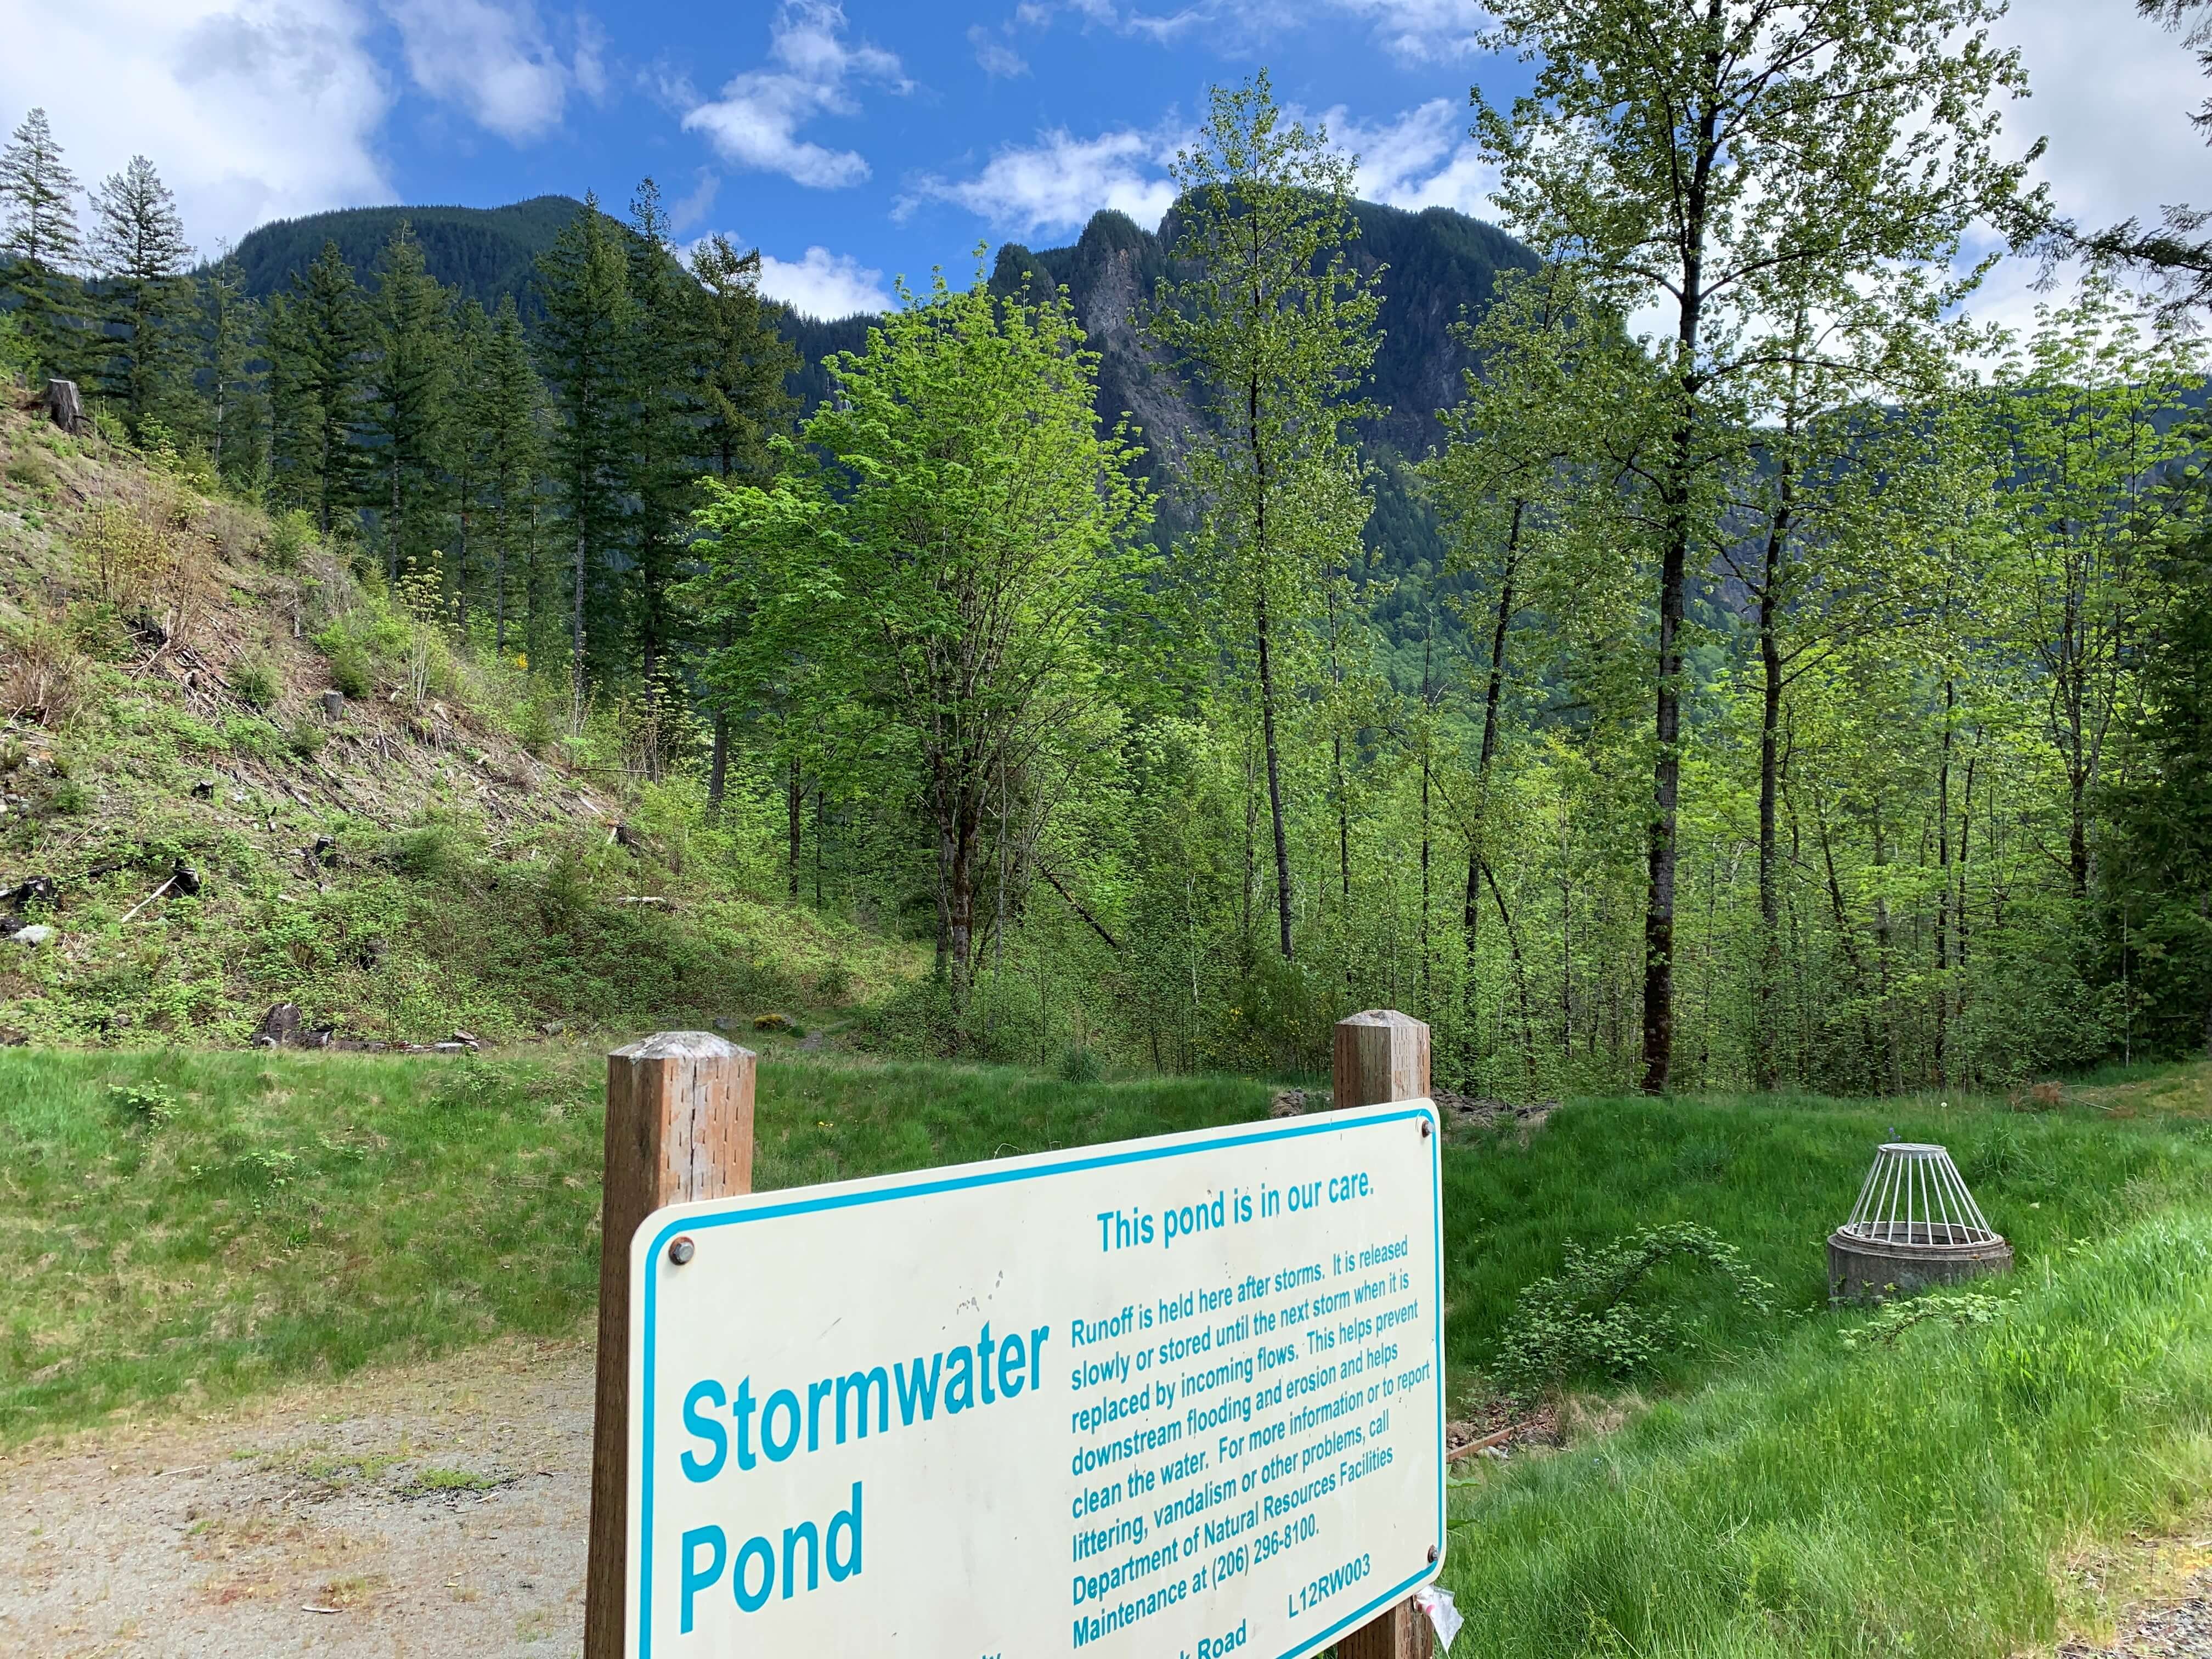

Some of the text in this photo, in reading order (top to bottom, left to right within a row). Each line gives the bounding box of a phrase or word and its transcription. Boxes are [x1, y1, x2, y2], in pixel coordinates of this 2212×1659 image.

[1097, 1172, 1374, 1252] This pond is in our care.
[1071, 1234, 1408, 1348] Runoff is held here after storms. It is released
[1071, 1268, 1409, 1391] slowly or stored until the next storm when it is
[680, 1321, 1050, 1483] Stormwater
[1071, 1343, 1398, 1476] downstream flooding and erosion and helps
[1072, 1299, 1418, 1435] replaced by incoming flows. This helps prevent
[1072, 1359, 1430, 1519] clean the water. For more information or to report
[1073, 1408, 1389, 1563] littering, vandalism or other problems, call
[680, 1480, 862, 1635] Pond
[1073, 1447, 1393, 1606] Department of Natural Resources Facilities
[1073, 1513, 1319, 1650] Maintenance at (206) 296-8100.
[1289, 1553, 1370, 1619] L12RW003
[1198, 1618, 1246, 1659] Road
